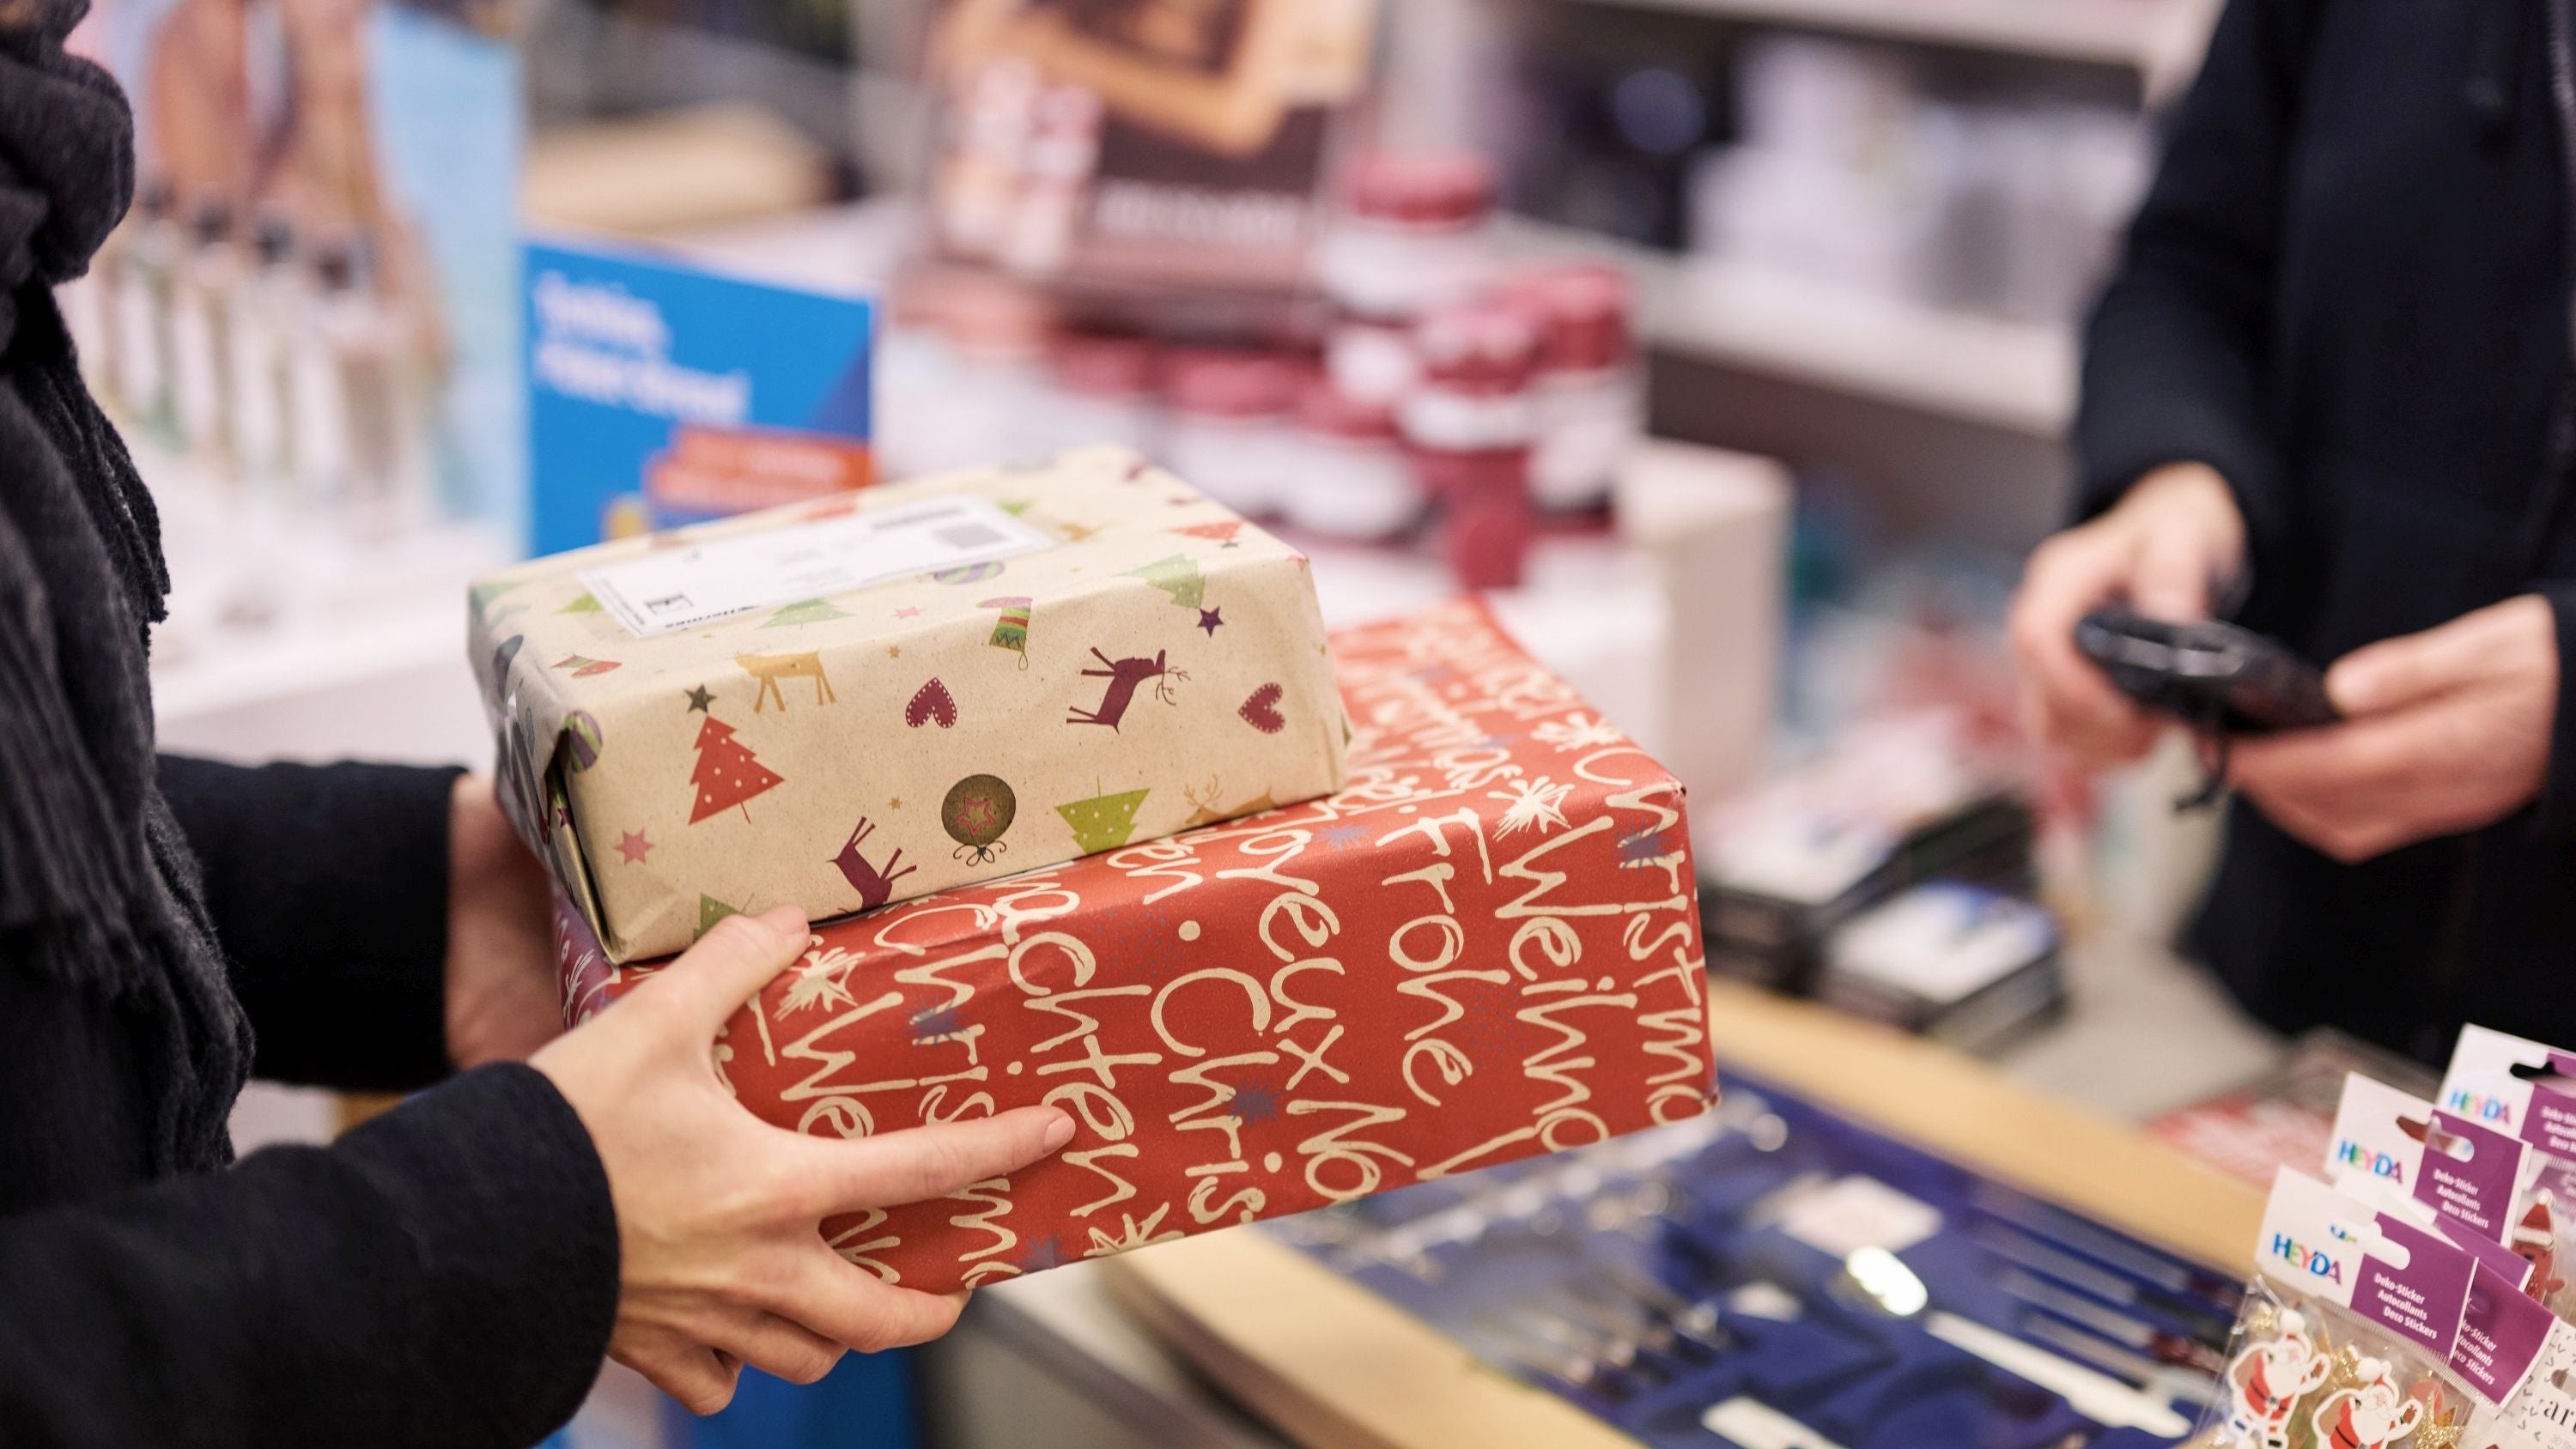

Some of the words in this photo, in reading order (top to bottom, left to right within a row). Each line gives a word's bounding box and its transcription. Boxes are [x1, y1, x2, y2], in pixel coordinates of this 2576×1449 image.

[1182, 800, 1350, 1091] Joyeux
[1375, 807, 1511, 1107] Frohe
[2450, 1088, 2511, 1125] HEYDA
[2338, 1140, 2403, 1185] HEYDA
[2433, 1168, 2479, 1196] Deko-Sticker
[2436, 1185, 2481, 1211] Autocollants
[2442, 1200, 2461, 1217] Deco
[2460, 1207, 2489, 1229] Stickers
[2271, 1233, 2342, 1286] HEYDA
[2373, 1271, 2426, 1305] Deko-Sticker
[2378, 1289, 2428, 1321] Autocollants
[2384, 1306, 2404, 1325] Deco
[2403, 1316, 2438, 1340] Stickers
[2466, 1358, 2495, 1385] Stickers
